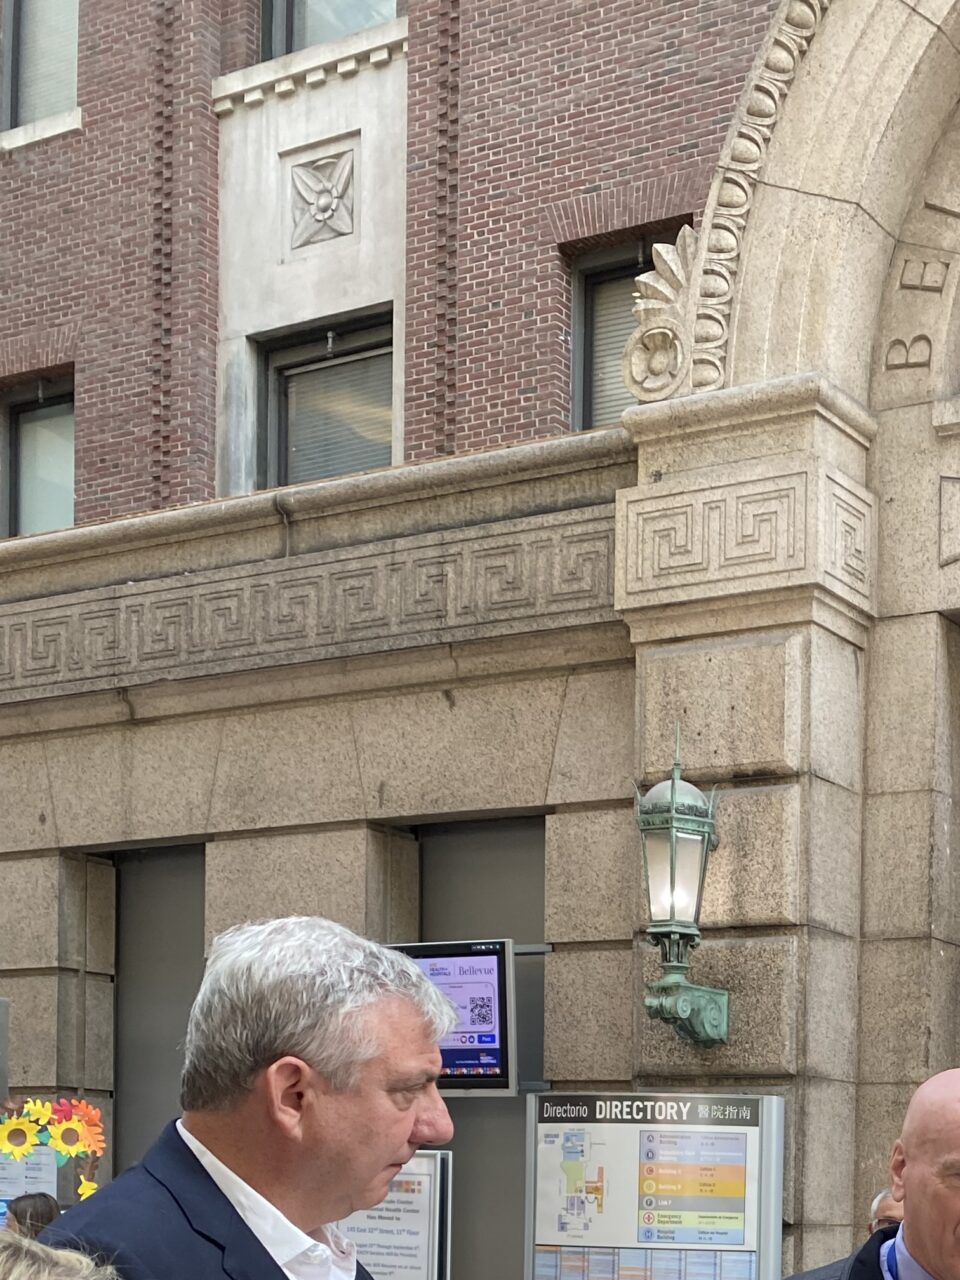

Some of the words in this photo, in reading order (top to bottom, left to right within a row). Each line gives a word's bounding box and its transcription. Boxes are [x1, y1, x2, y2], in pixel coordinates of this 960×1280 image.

[458, 966, 495, 976] Bellevue
[543, 1102, 588, 1118] Directorio
[595, 1101, 691, 1120] DIRECTORY
